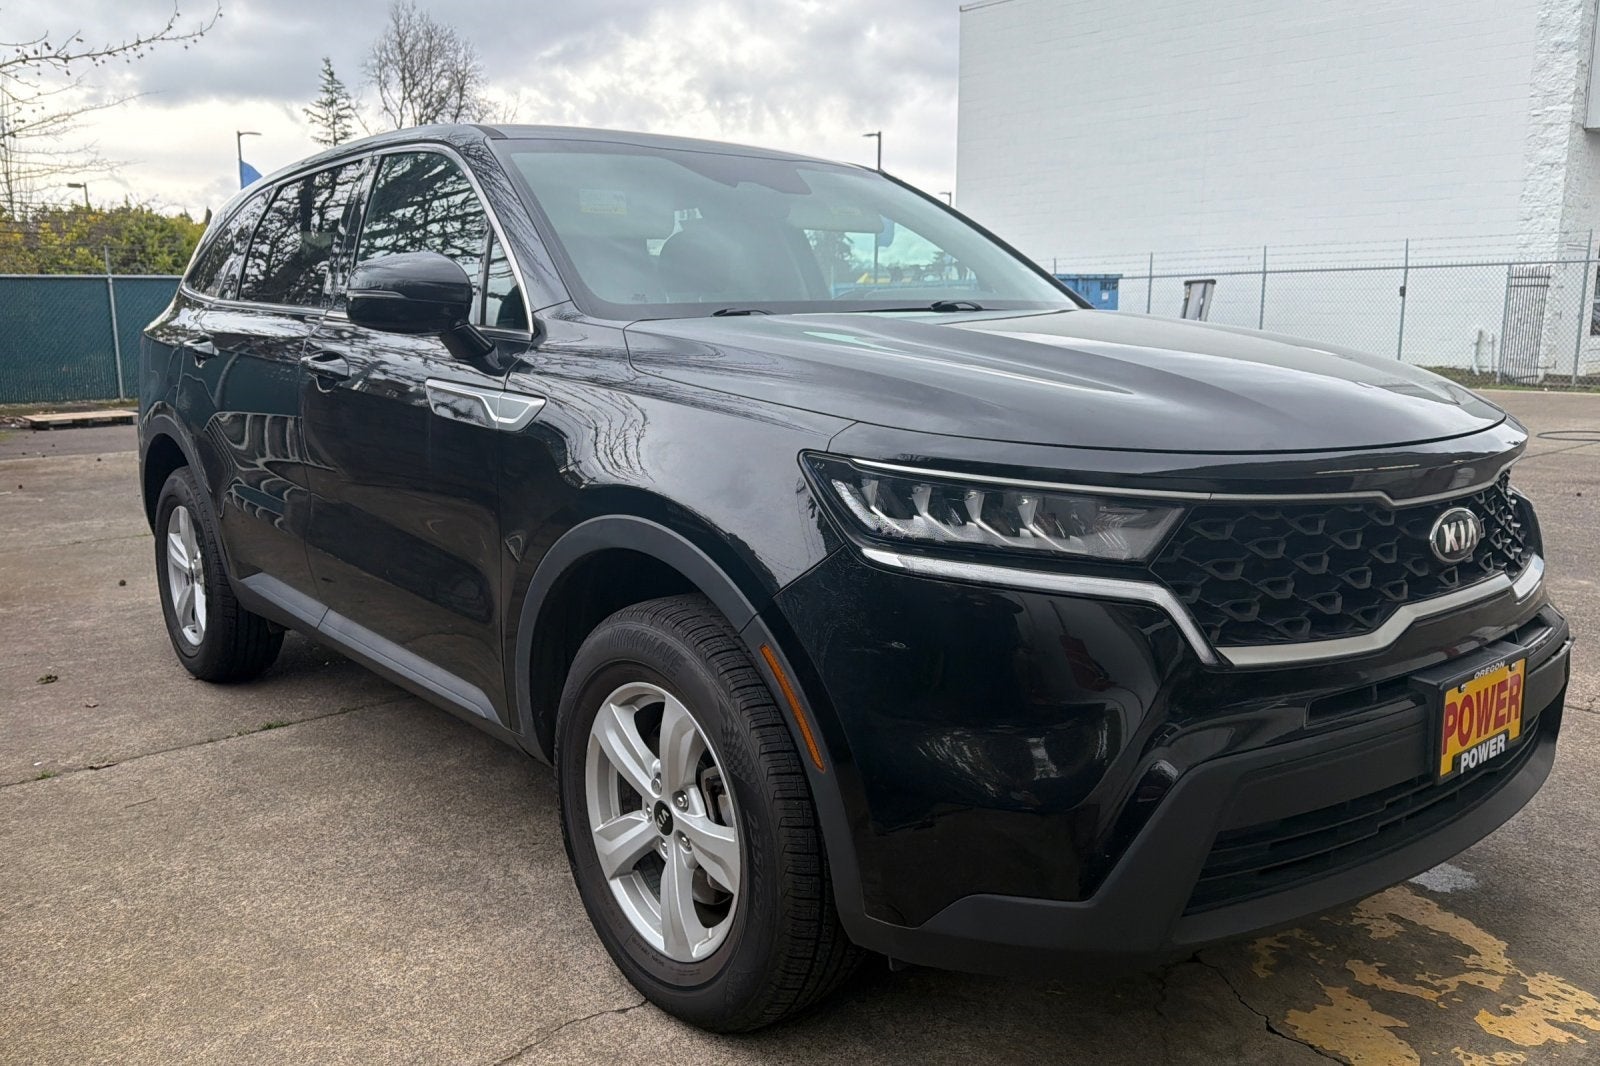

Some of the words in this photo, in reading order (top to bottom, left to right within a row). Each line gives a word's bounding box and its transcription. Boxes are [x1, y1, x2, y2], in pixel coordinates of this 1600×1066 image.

[1441, 518, 1477, 553] KIA
[1474, 660, 1506, 680] OREGON
[1442, 673, 1522, 756] POWER
[1460, 733, 1506, 774] POWER
